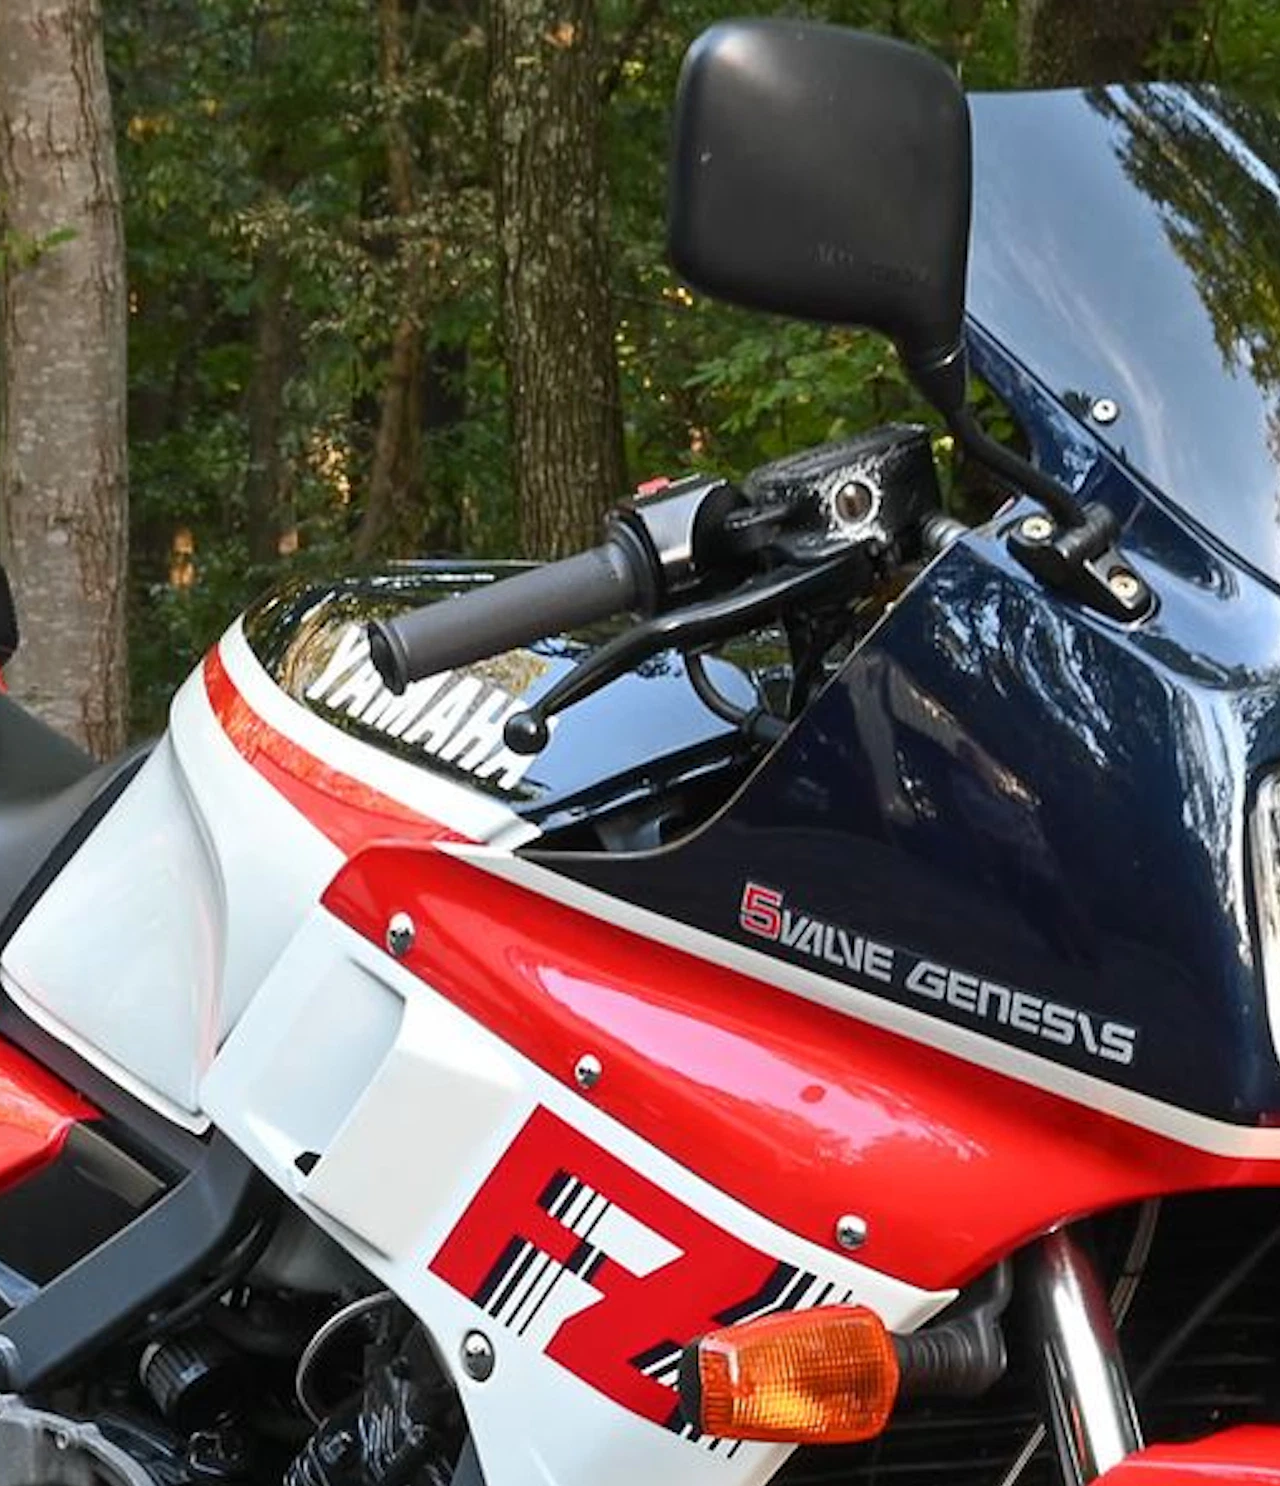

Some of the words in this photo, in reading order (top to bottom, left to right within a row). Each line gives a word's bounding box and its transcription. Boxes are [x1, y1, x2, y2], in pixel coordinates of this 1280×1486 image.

[304, 622, 560, 791] YAMAHA
[904, 960, 1138, 1066] GENESIS
[426, 1101, 854, 1459] FZ
